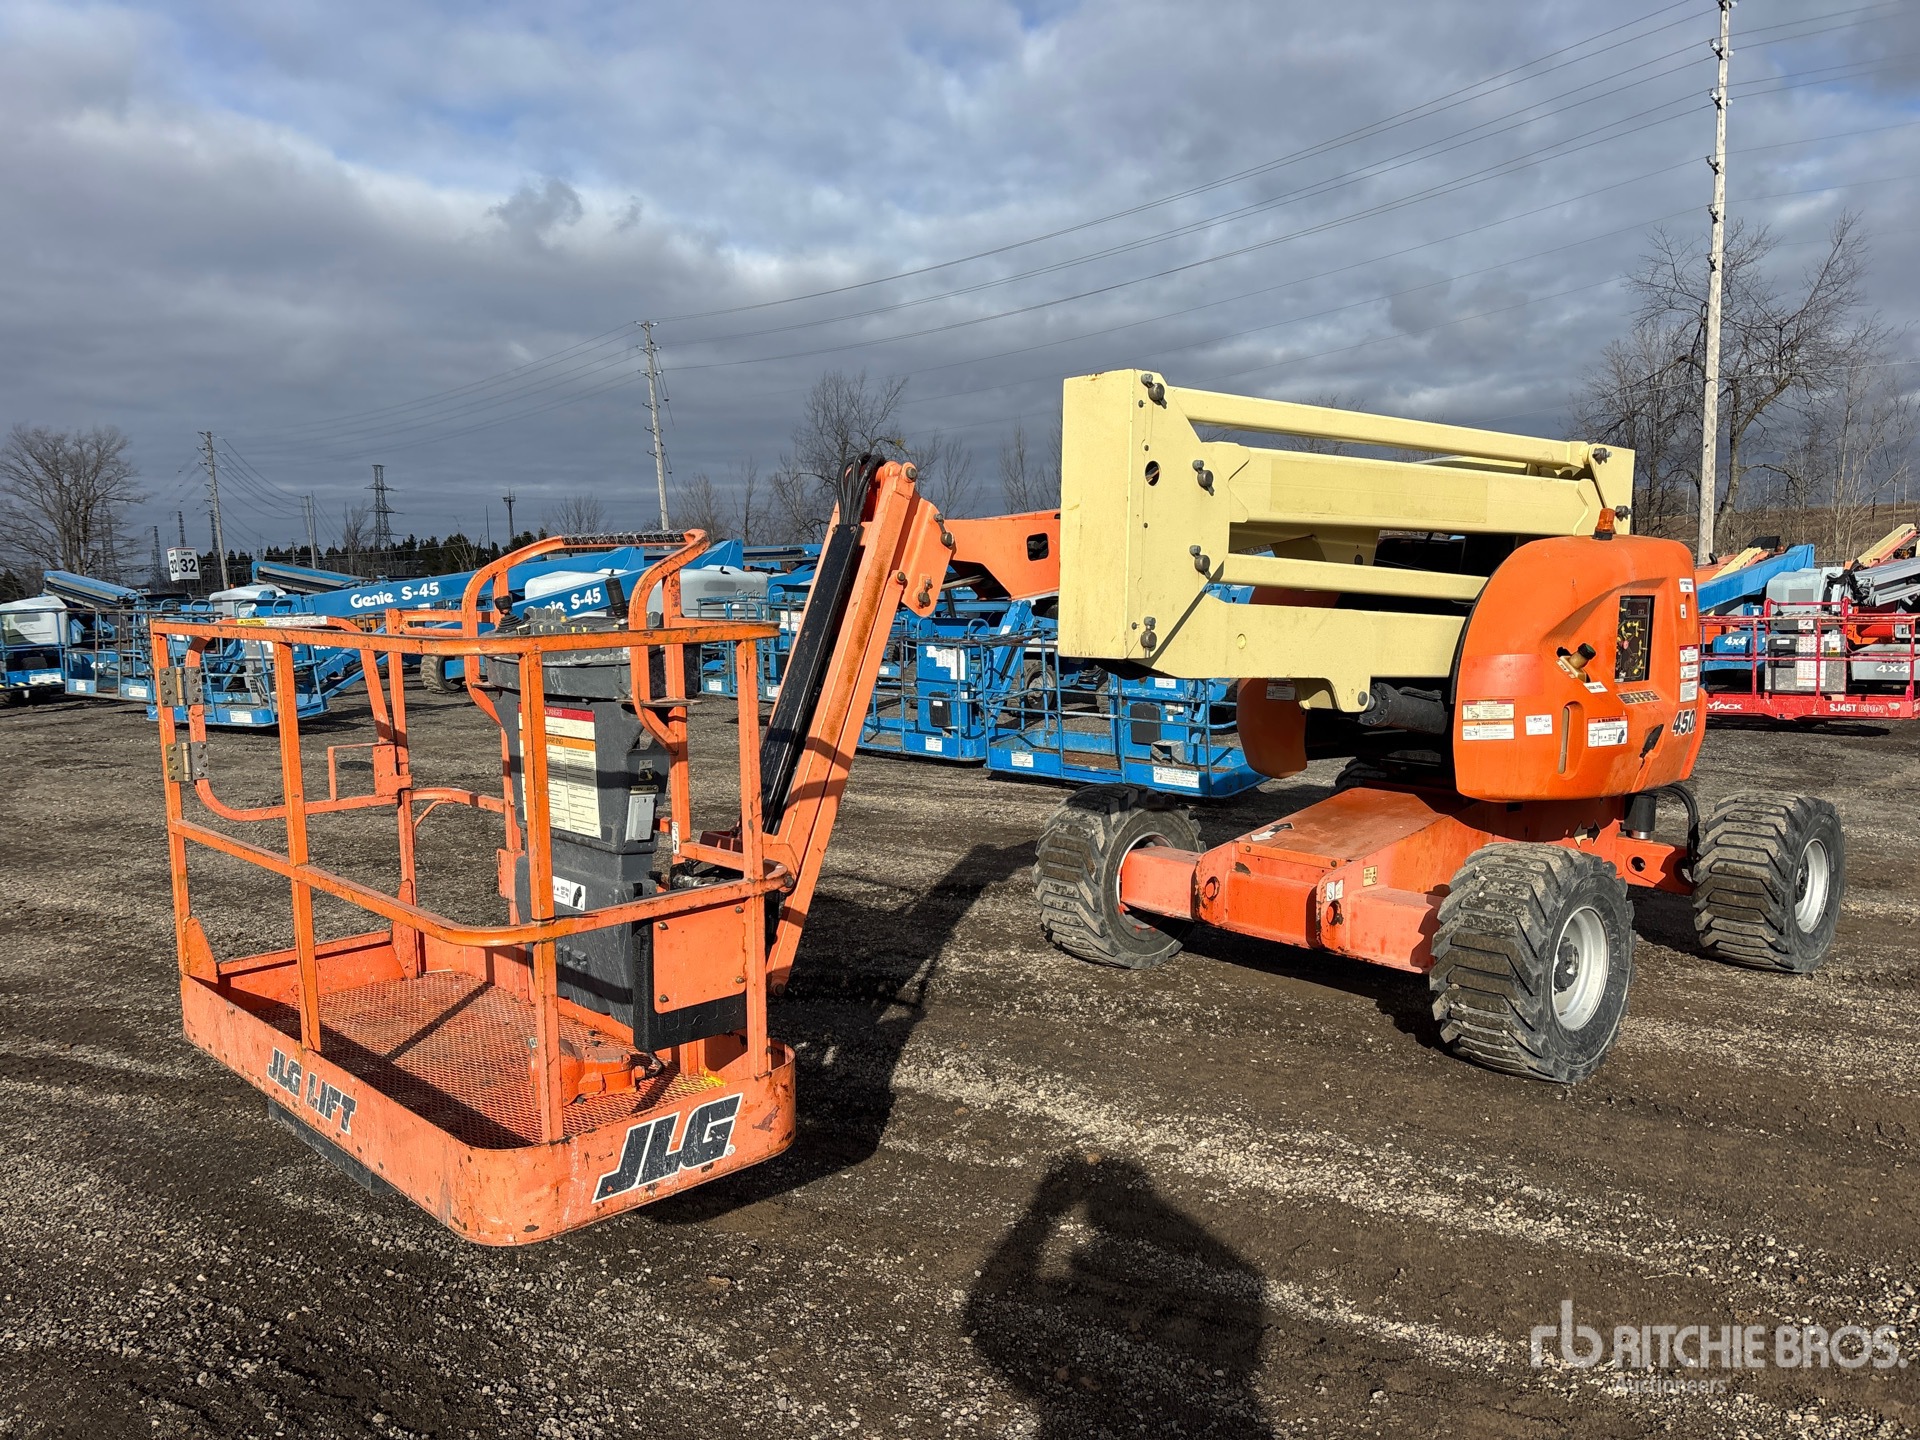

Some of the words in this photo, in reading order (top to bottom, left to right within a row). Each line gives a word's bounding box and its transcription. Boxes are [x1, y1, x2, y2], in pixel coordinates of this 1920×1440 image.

[180, 558, 197, 573] 32
[350, 591, 394, 609] Genie
[401, 581, 439, 601] S-45
[570, 587, 601, 610] S-45
[1724, 636, 1747, 646] 4x4
[1876, 664, 1910, 674] 4x4
[1706, 700, 1743, 711] YJACK
[1829, 703, 1857, 712] SJ45T
[267, 1047, 303, 1098] JLG
[305, 1071, 358, 1135] LIFT
[591, 1092, 744, 1204] JLG
